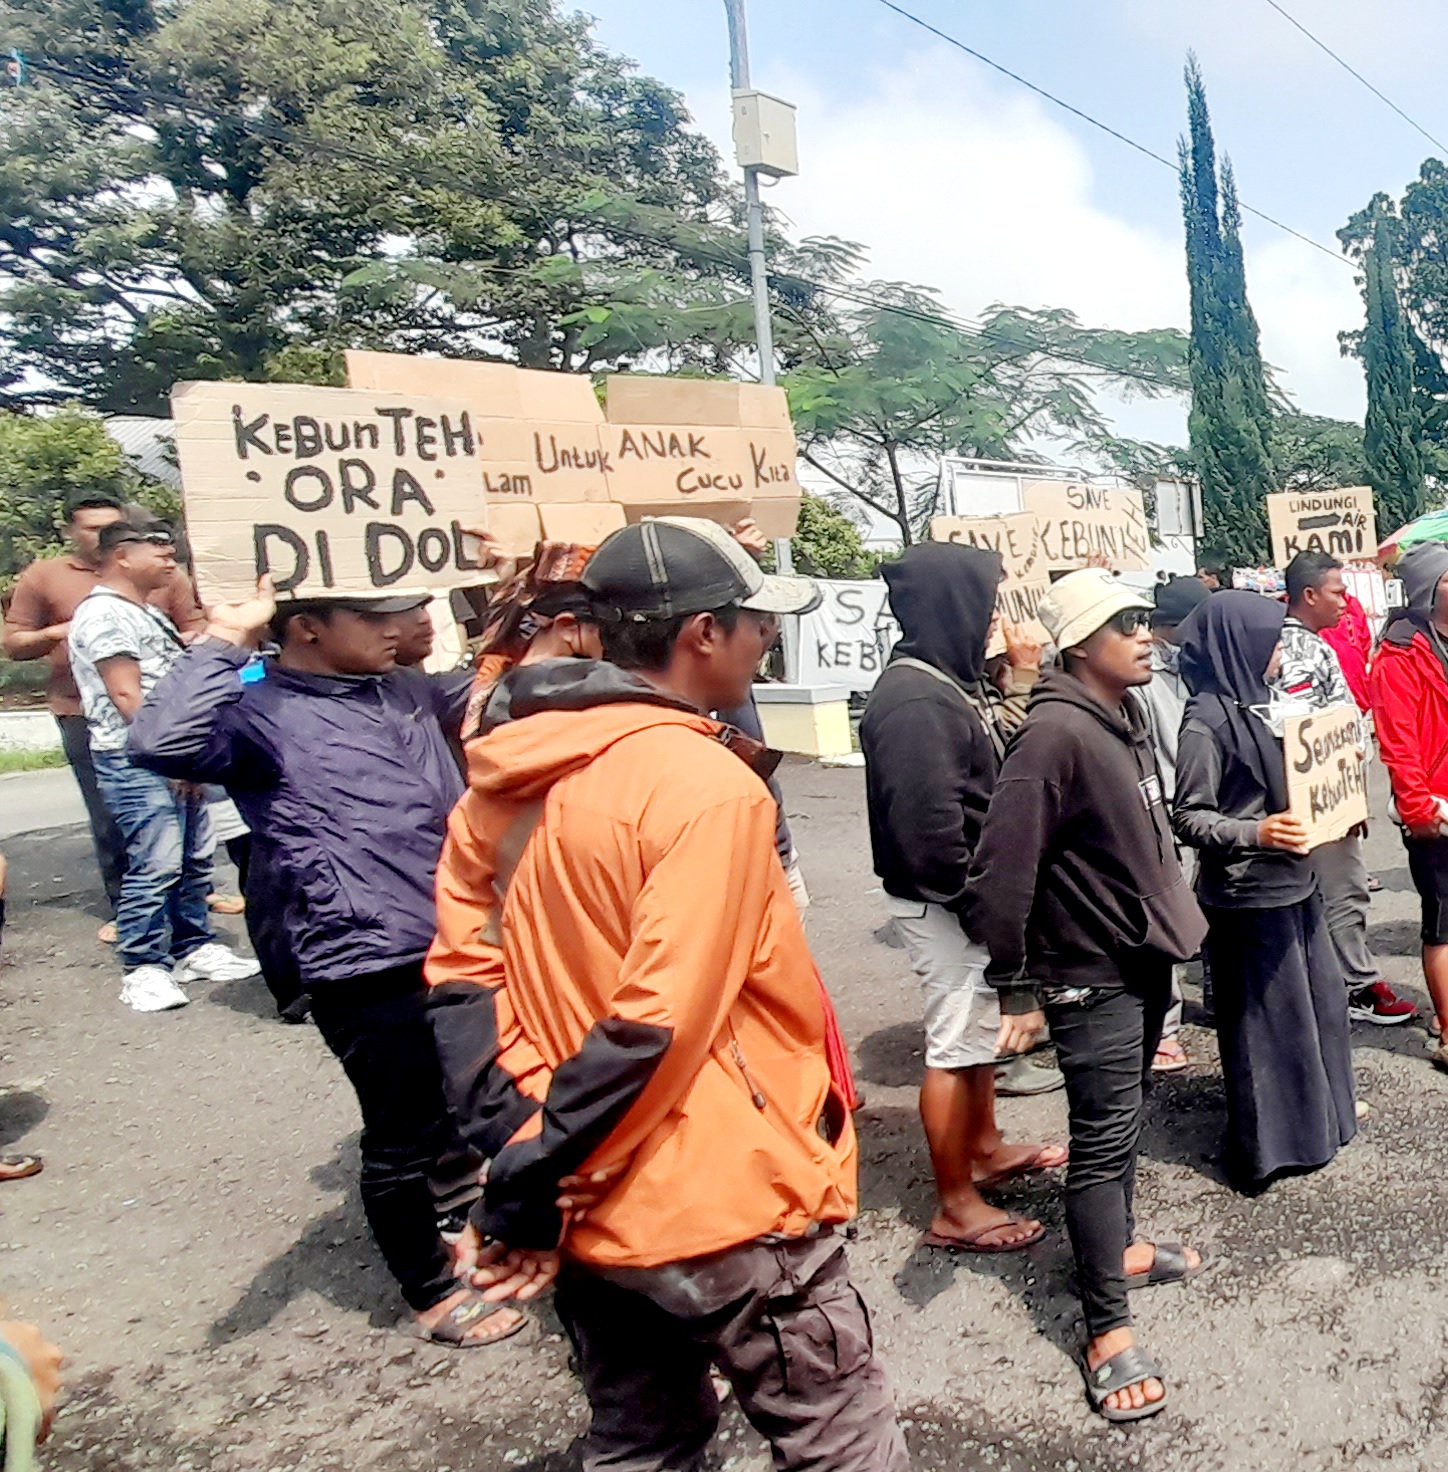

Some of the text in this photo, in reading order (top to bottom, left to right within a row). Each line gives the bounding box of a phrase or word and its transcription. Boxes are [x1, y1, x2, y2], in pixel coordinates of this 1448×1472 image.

[534, 428, 711, 474] Untuk ANAK
[1066, 485, 1113, 511] SAVE
[1289, 496, 1358, 513] LINDUNGI
[253, 523, 335, 592] DI
[1284, 529, 1363, 560] KAMI
